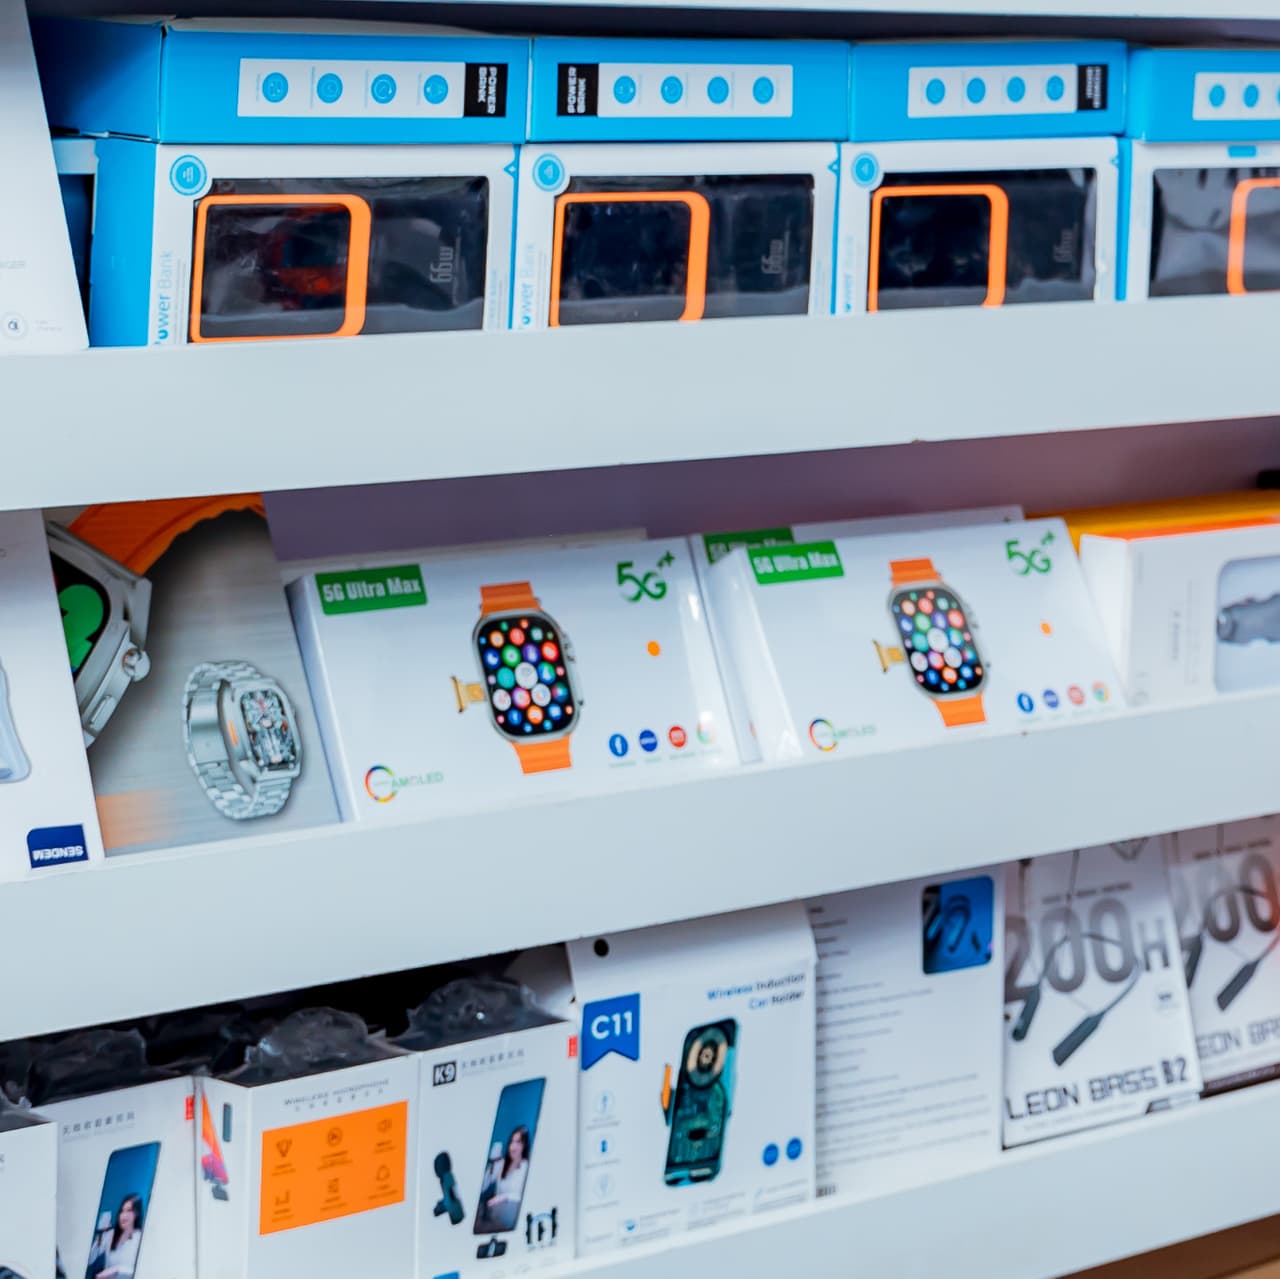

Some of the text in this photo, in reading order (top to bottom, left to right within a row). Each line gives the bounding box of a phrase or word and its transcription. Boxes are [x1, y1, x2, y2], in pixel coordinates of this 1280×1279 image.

[346, 580, 386, 601] Ultra
[388, 576, 421, 597] Max
[32, 845, 84, 862] SENDEM
[590, 1010, 633, 1040] C11
[1196, 1028, 1241, 1058] EON
[434, 1063, 456, 1083] K9
